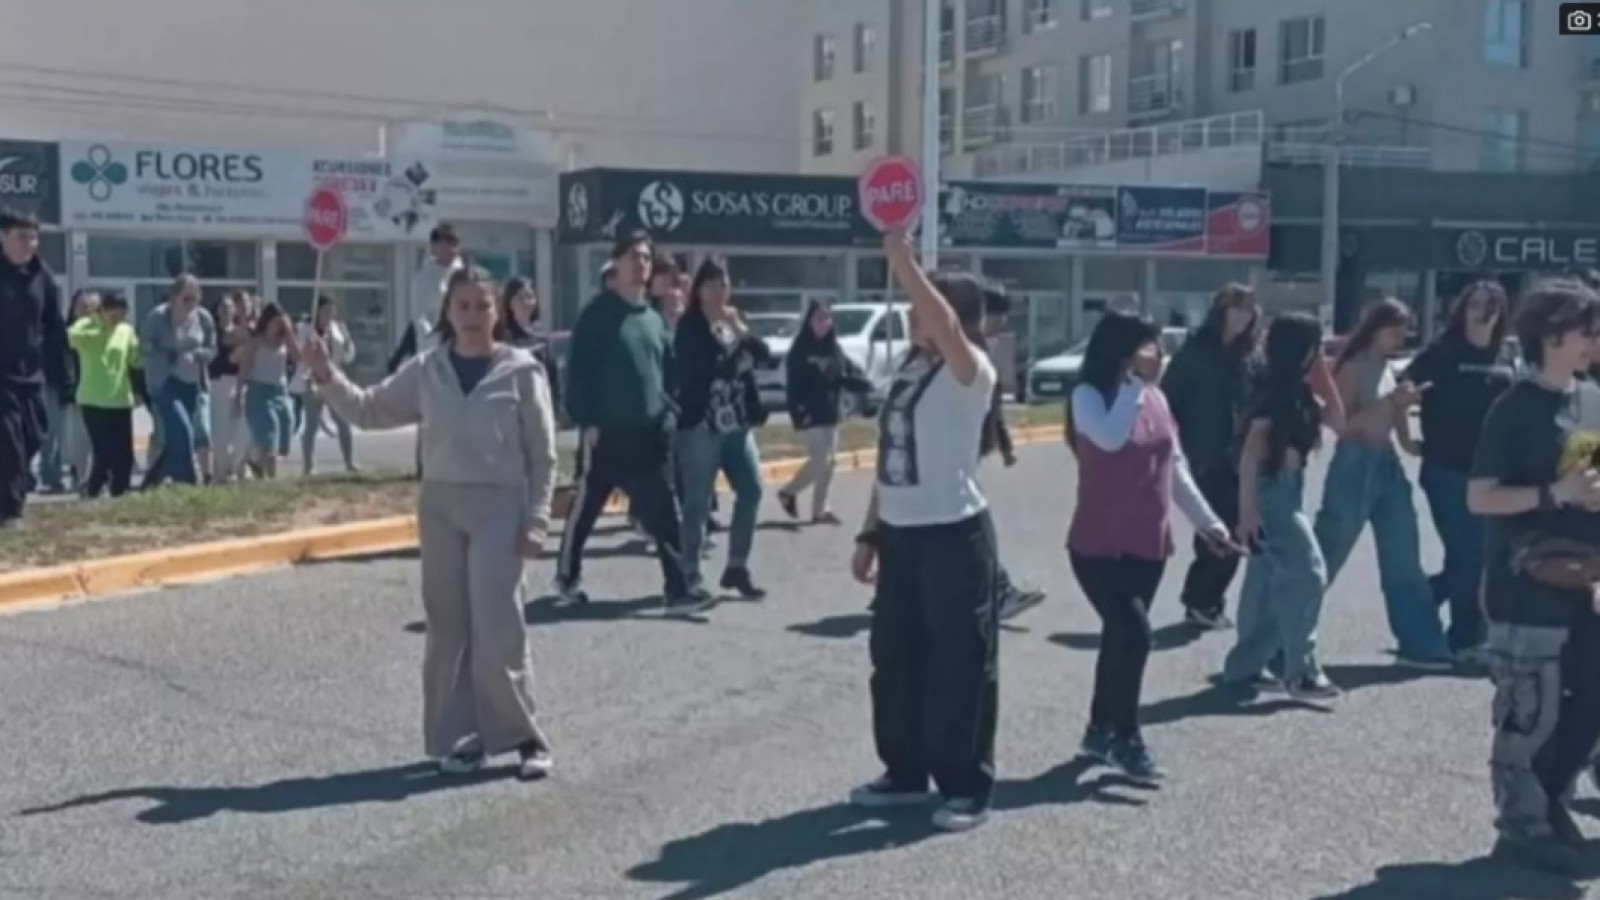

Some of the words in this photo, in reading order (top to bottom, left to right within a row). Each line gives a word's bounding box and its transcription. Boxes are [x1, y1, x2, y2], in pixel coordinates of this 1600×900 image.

[136, 150, 263, 183] FLORES
[0, 173, 37, 194] SUR
[868, 180, 915, 203] PARE
[691, 190, 769, 216] SOSA'S
[1494, 237, 1599, 263] CALE
